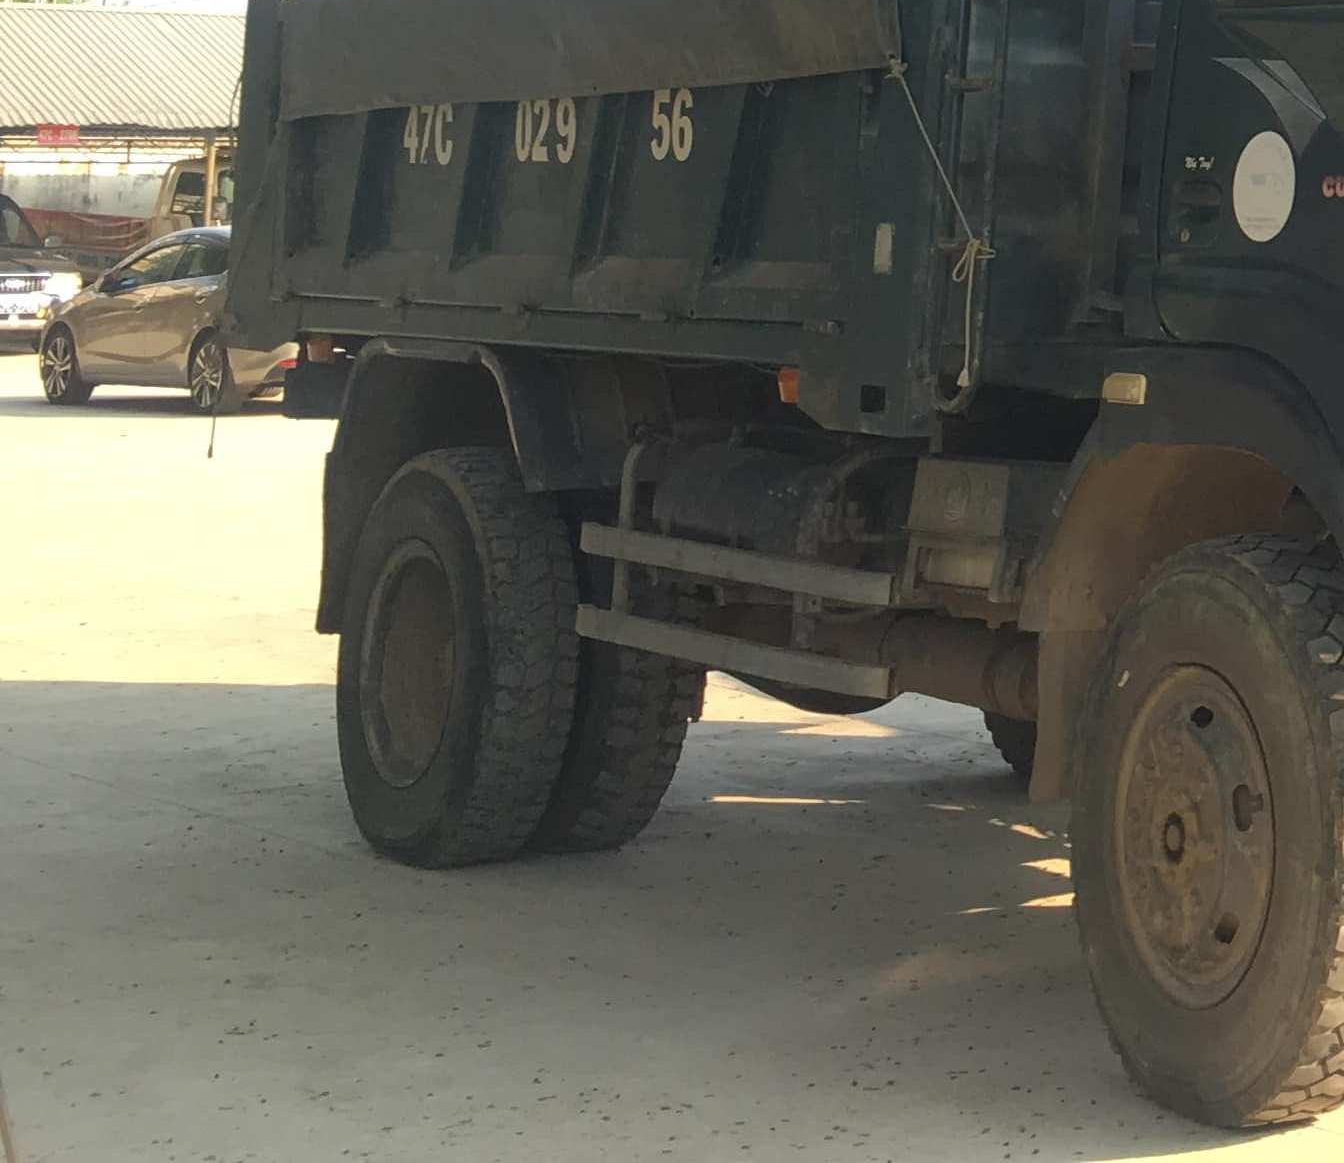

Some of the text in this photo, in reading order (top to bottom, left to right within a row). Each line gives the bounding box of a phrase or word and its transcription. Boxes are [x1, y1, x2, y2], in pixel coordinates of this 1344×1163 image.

[403, 87, 694, 165] 47C 029 56
